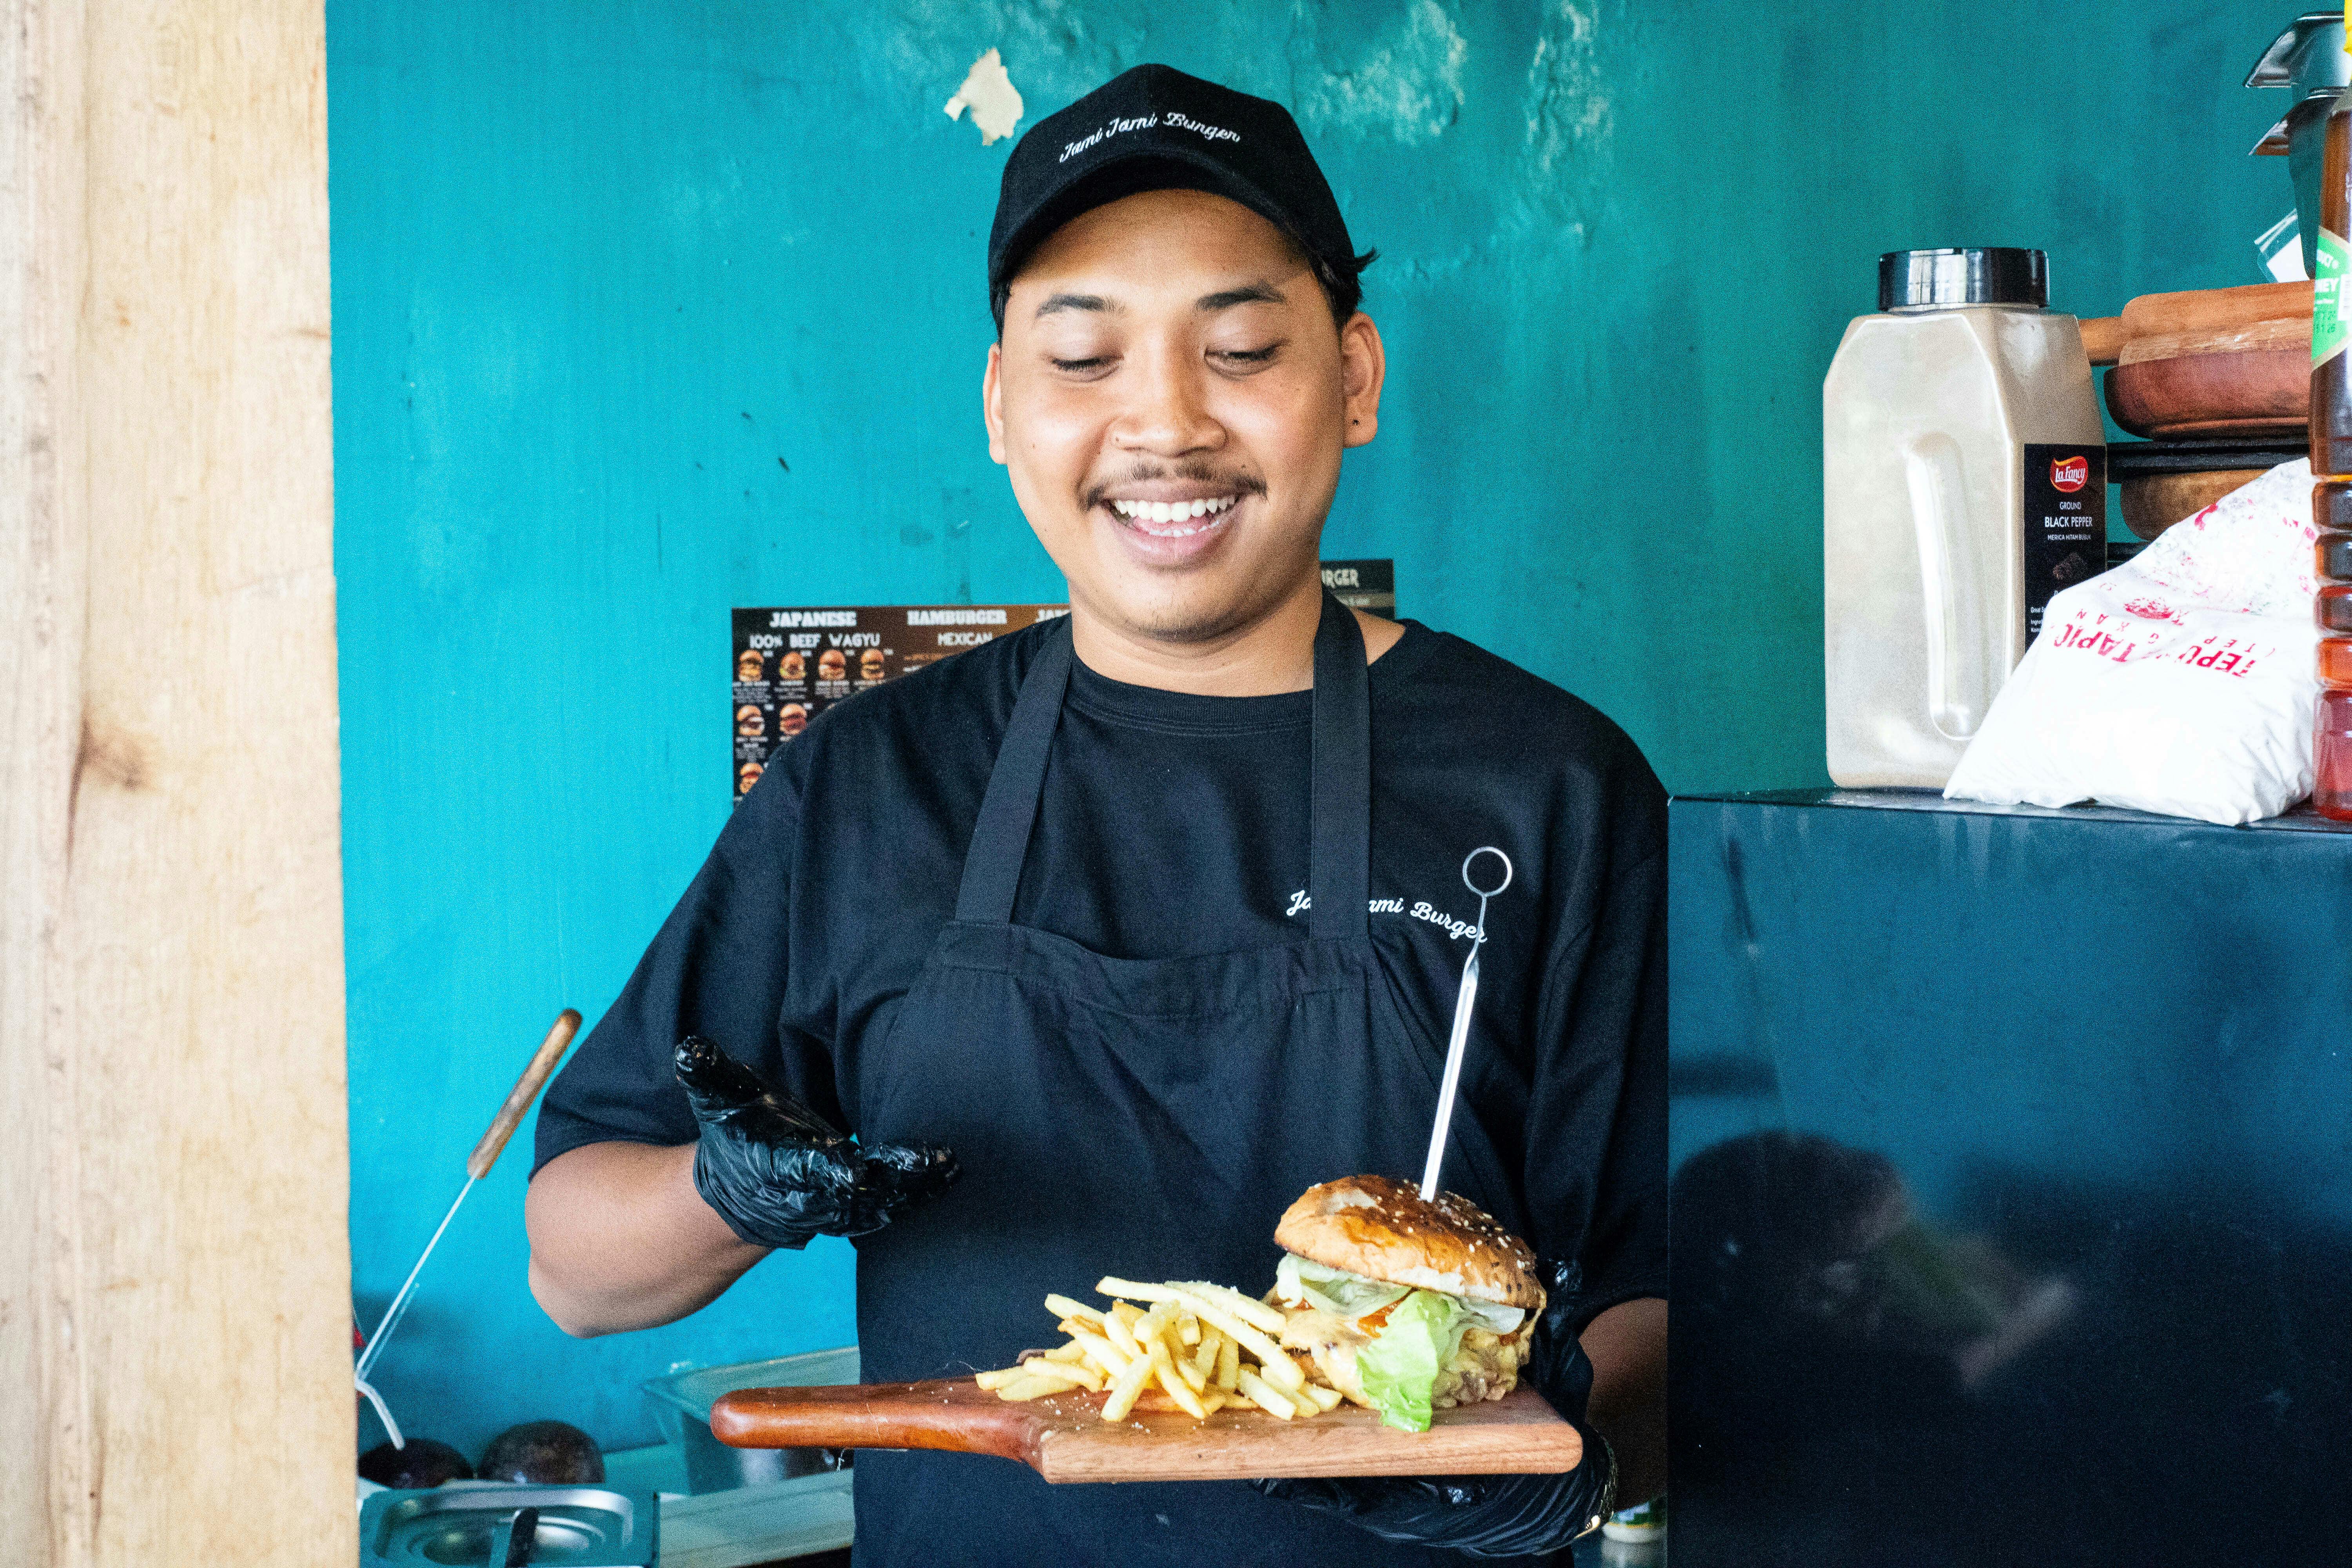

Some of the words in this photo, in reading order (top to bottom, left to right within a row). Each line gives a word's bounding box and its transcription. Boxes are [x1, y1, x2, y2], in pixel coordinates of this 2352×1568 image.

[1163, 112, 1240, 143] Burger
[2065, 466, 2086, 485] Fancy
[2060, 502, 2082, 510] GROUND
[2045, 516, 2069, 528] BLACK
[2071, 516, 2092, 527] PEPPER
[769, 611, 857, 628] JAPANESE
[907, 610, 1007, 626] HAMBURGER
[829, 633, 880, 647] WAGYU
